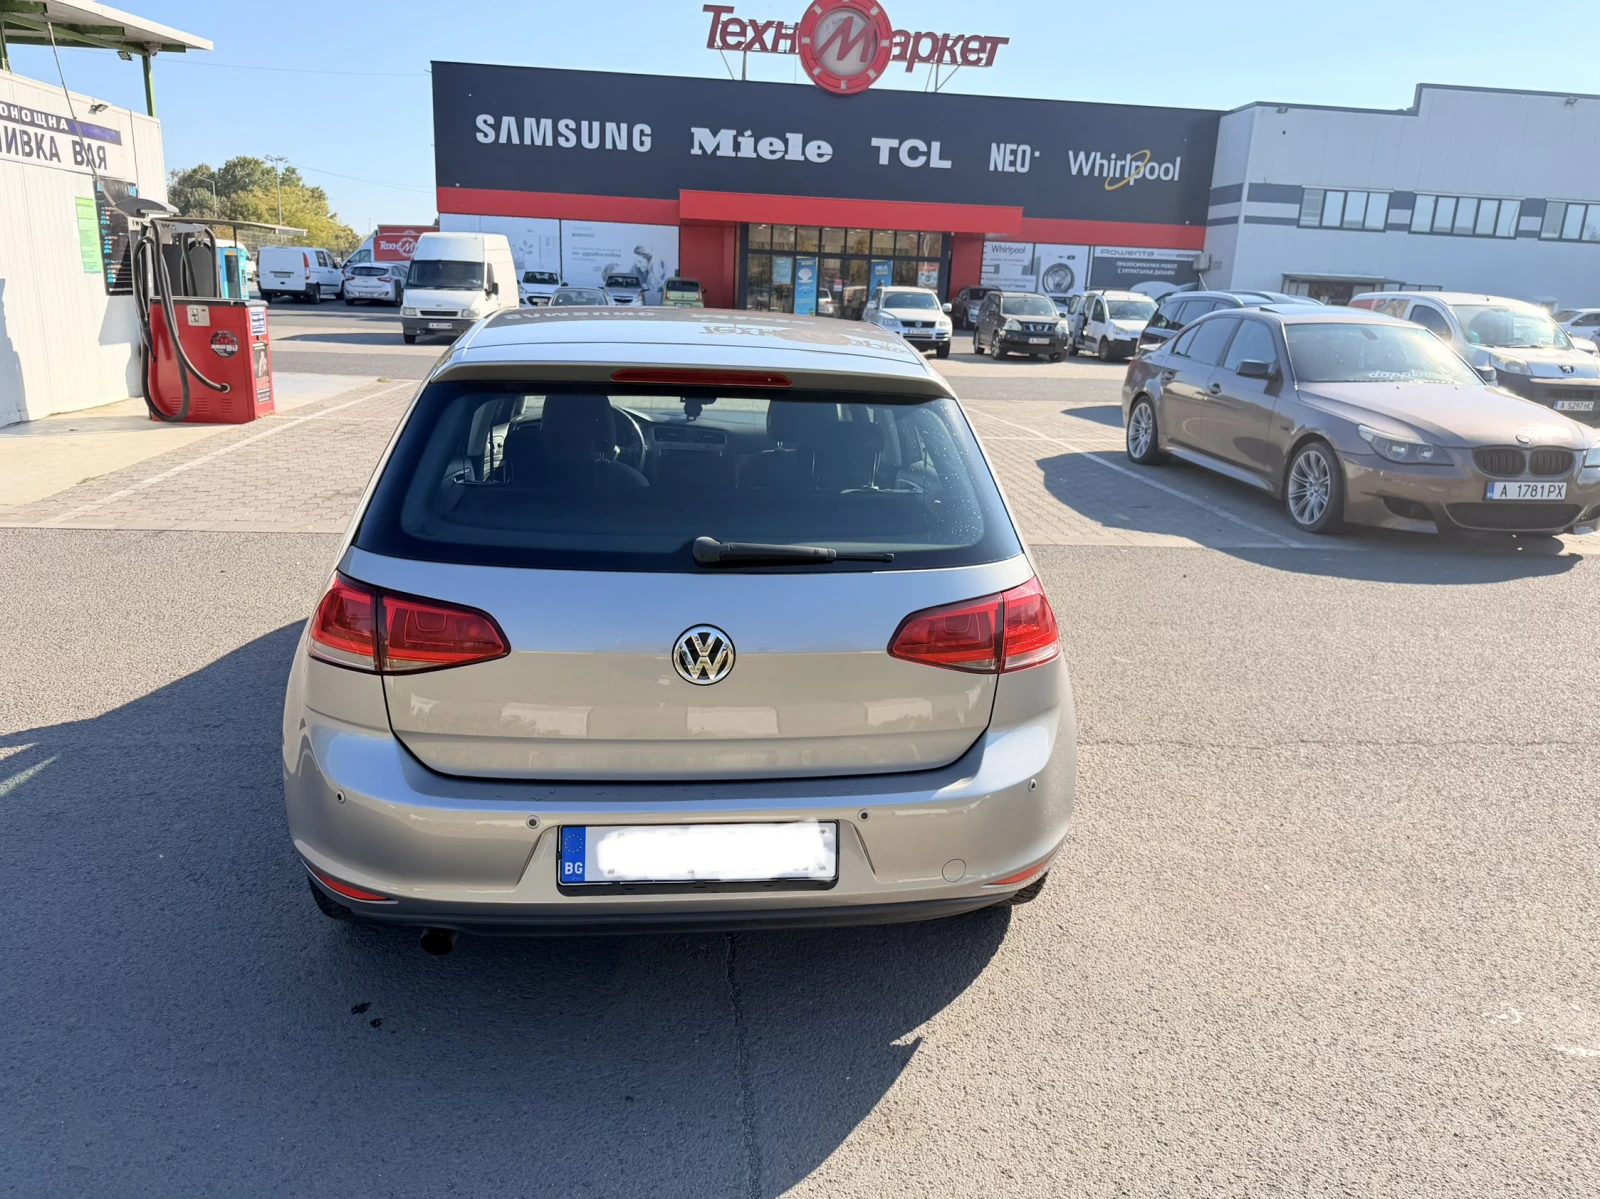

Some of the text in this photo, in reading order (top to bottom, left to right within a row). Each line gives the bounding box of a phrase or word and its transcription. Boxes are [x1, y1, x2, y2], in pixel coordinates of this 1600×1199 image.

[0, 125, 108, 171] ИВКА ВАЯ
[475, 113, 652, 153] SAMSUNG
[690, 127, 834, 163] Miele
[871, 137, 952, 169] TCL
[1068, 150, 1181, 186] Whirlpool
[991, 245, 1026, 256] Whirlpool
[1500, 484, 1507, 498] A
[564, 862, 583, 875] BG
